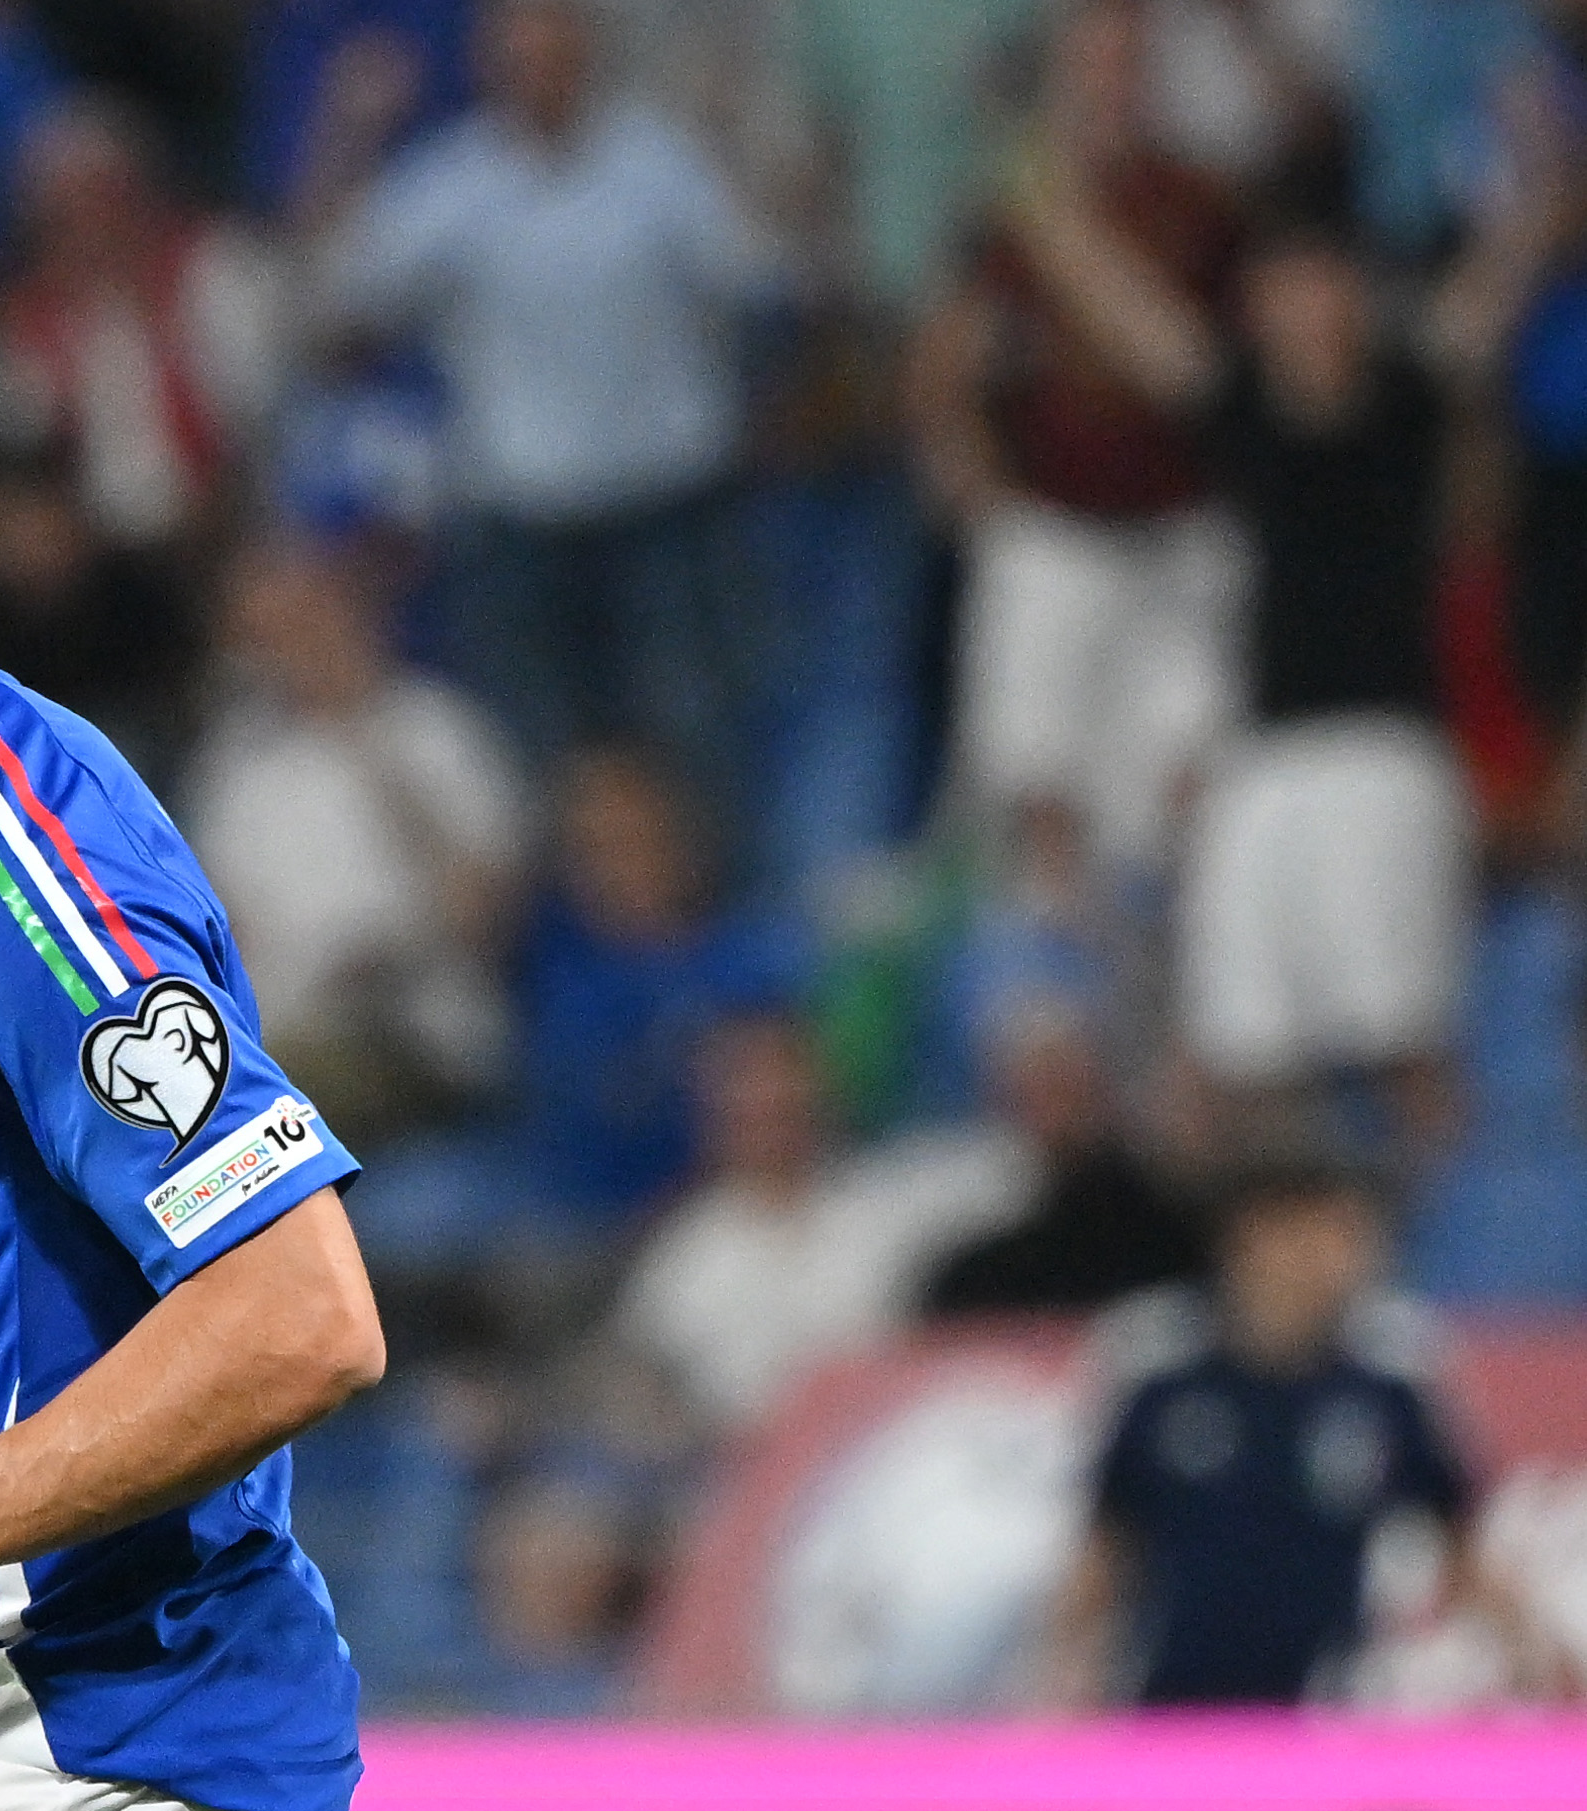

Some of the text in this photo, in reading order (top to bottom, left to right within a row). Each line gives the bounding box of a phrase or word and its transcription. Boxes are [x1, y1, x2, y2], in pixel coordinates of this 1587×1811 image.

[264, 1116, 306, 1152] 10
[152, 1185, 179, 1209] UEFA
[161, 1143, 271, 1228] FOUNDATION
